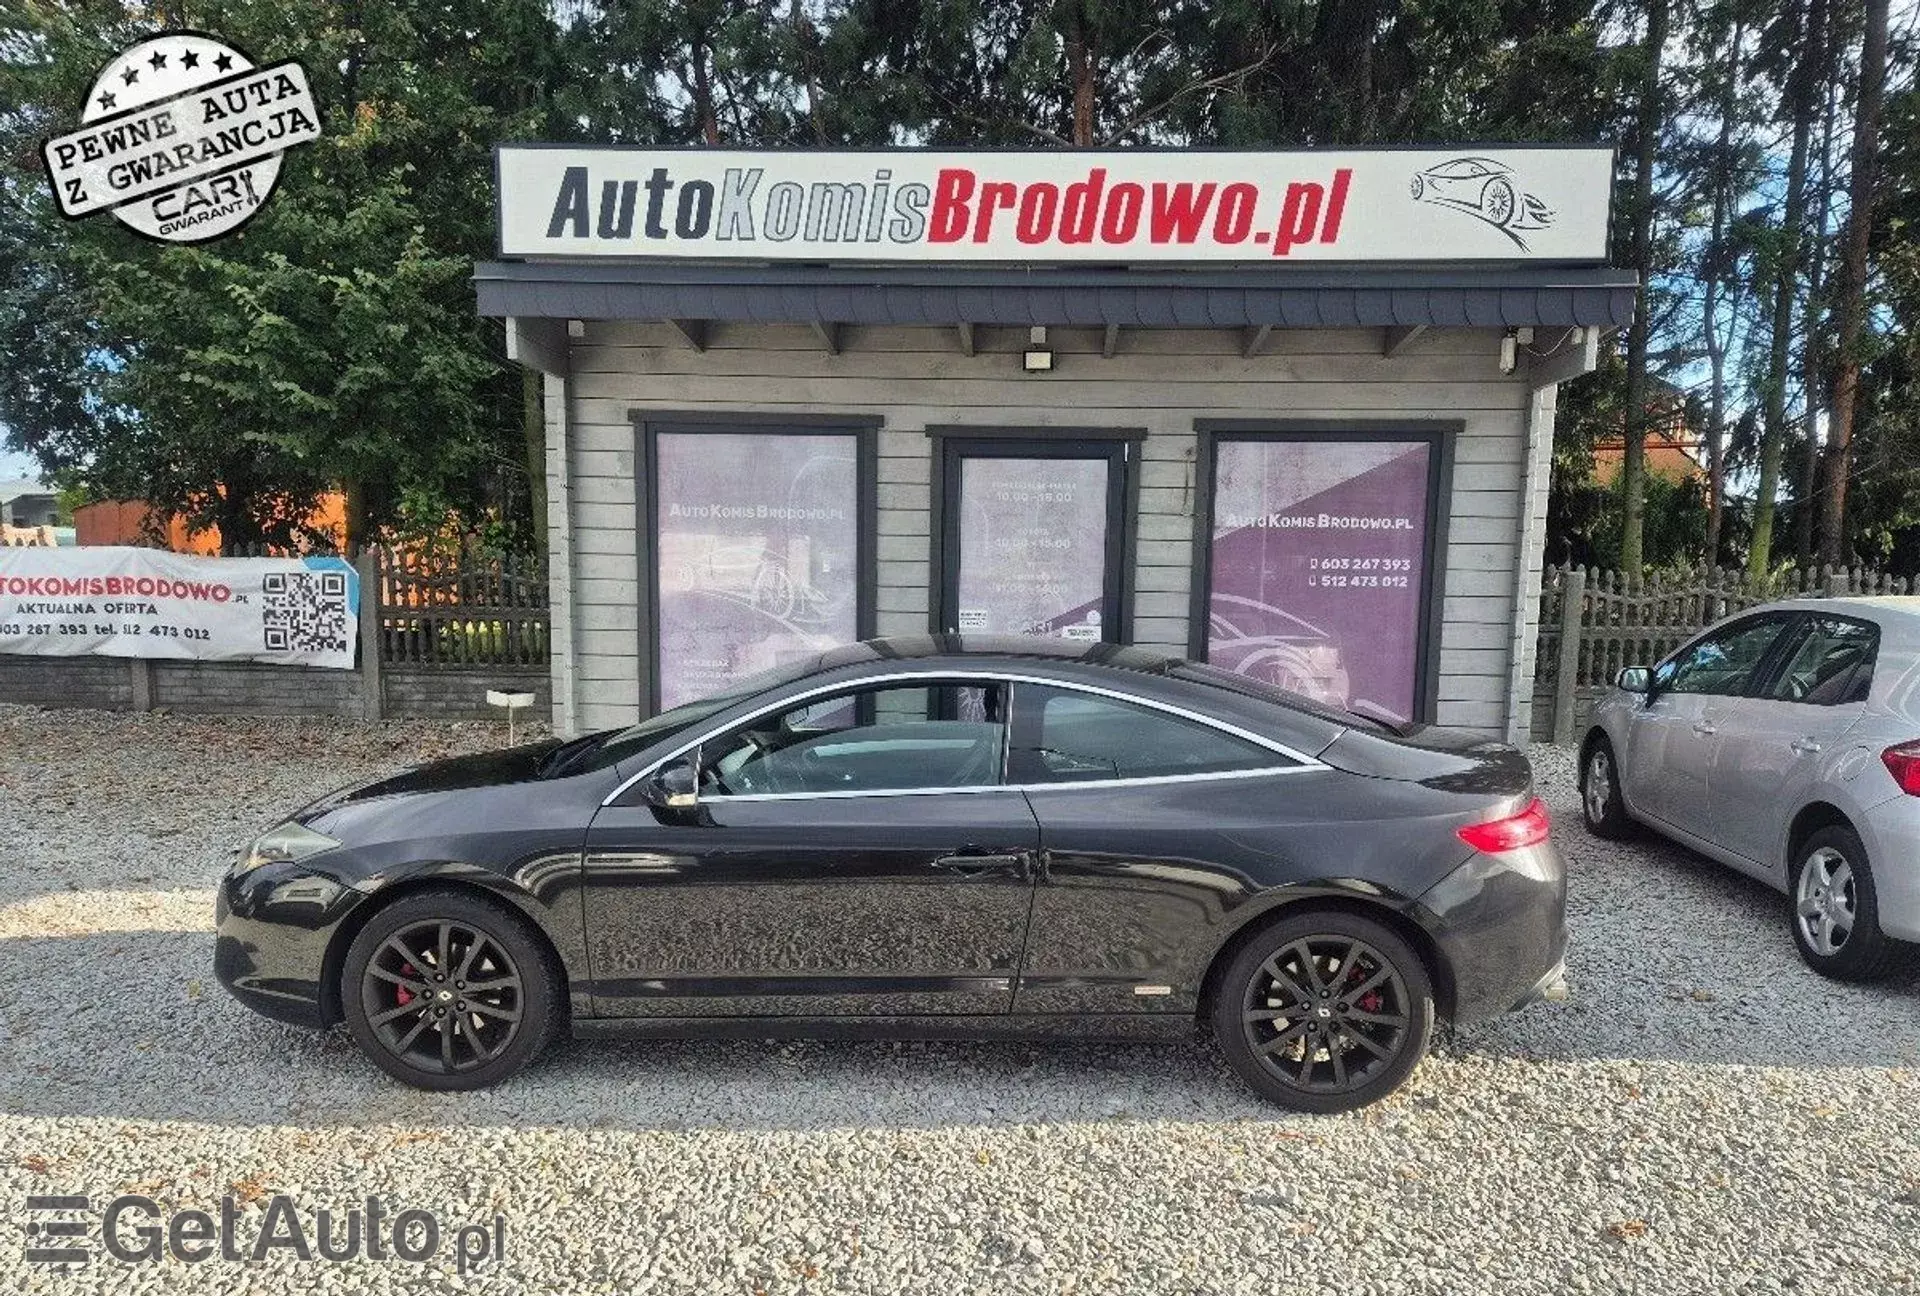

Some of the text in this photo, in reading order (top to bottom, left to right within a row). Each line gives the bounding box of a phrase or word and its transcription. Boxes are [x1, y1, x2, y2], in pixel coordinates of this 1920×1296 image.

[546, 166, 1352, 256] AutoKomisBrodowo.pl
[1321, 559, 1411, 571] 603 267 393
[1321, 576, 1408, 587] 512 473 012
[16, 602, 158, 615] AKTUALNA OFERTA
[26, 623, 51, 635] 267
[58, 623, 88, 636] 393
[94, 623, 118, 636] tel.
[149, 625, 179, 638] 473
[184, 627, 211, 640] 012
